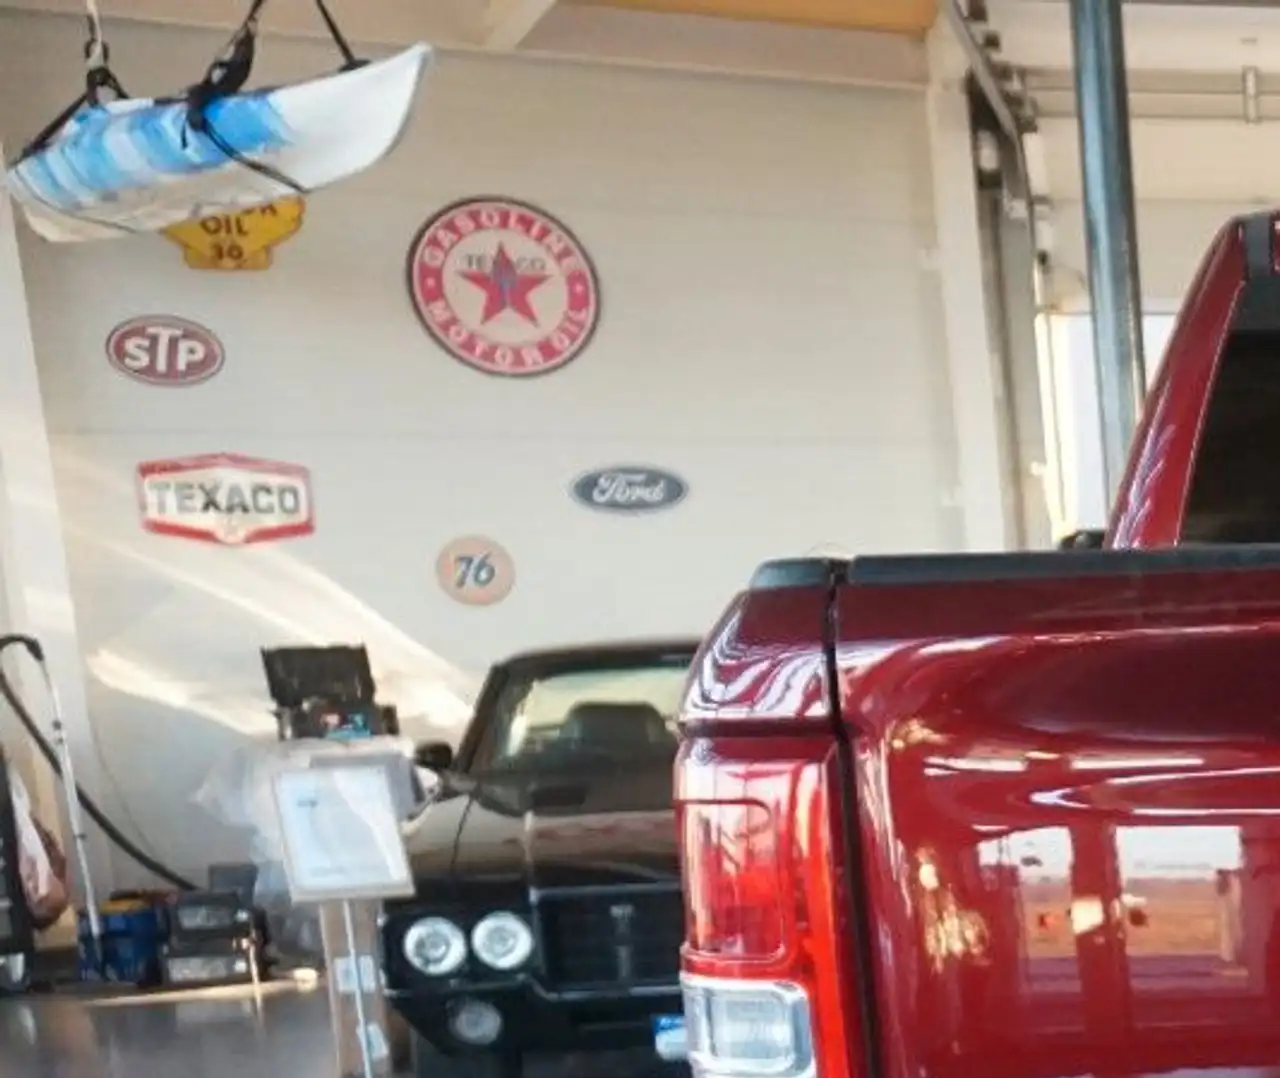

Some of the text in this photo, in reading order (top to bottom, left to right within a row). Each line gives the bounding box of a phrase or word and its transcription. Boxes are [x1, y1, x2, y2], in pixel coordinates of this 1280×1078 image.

[423, 207, 581, 272] GASOLINE
[123, 325, 206, 374] STP
[427, 299, 545, 368] MOTOR
[148, 481, 300, 514] TEXACO
[591, 472, 665, 502] Ford
[454, 552, 496, 589] 76
